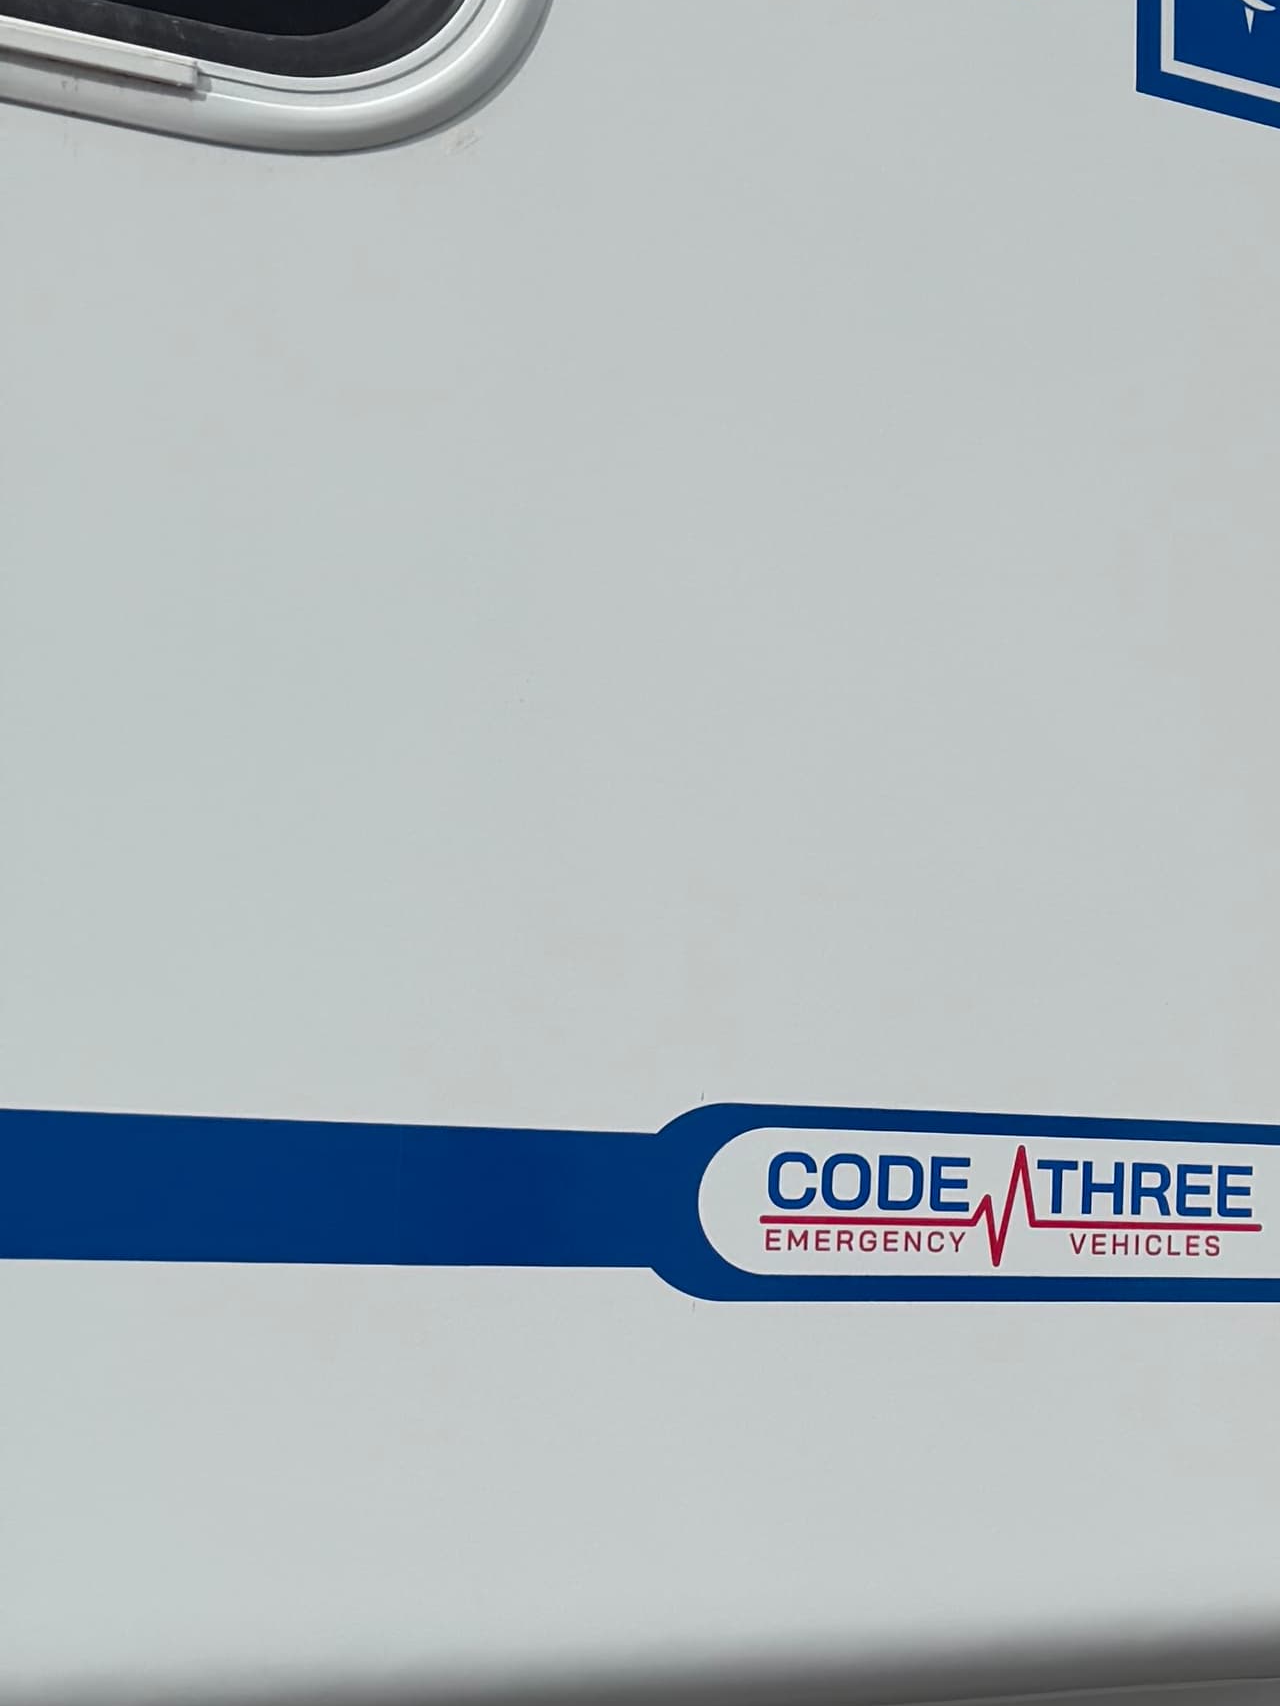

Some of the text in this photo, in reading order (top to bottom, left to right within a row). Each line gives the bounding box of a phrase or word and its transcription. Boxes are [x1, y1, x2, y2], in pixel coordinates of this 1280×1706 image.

[767, 1151, 1254, 1219] CODE THREE
[765, 1229, 1221, 1257] EMERGENCY VEHICLES
